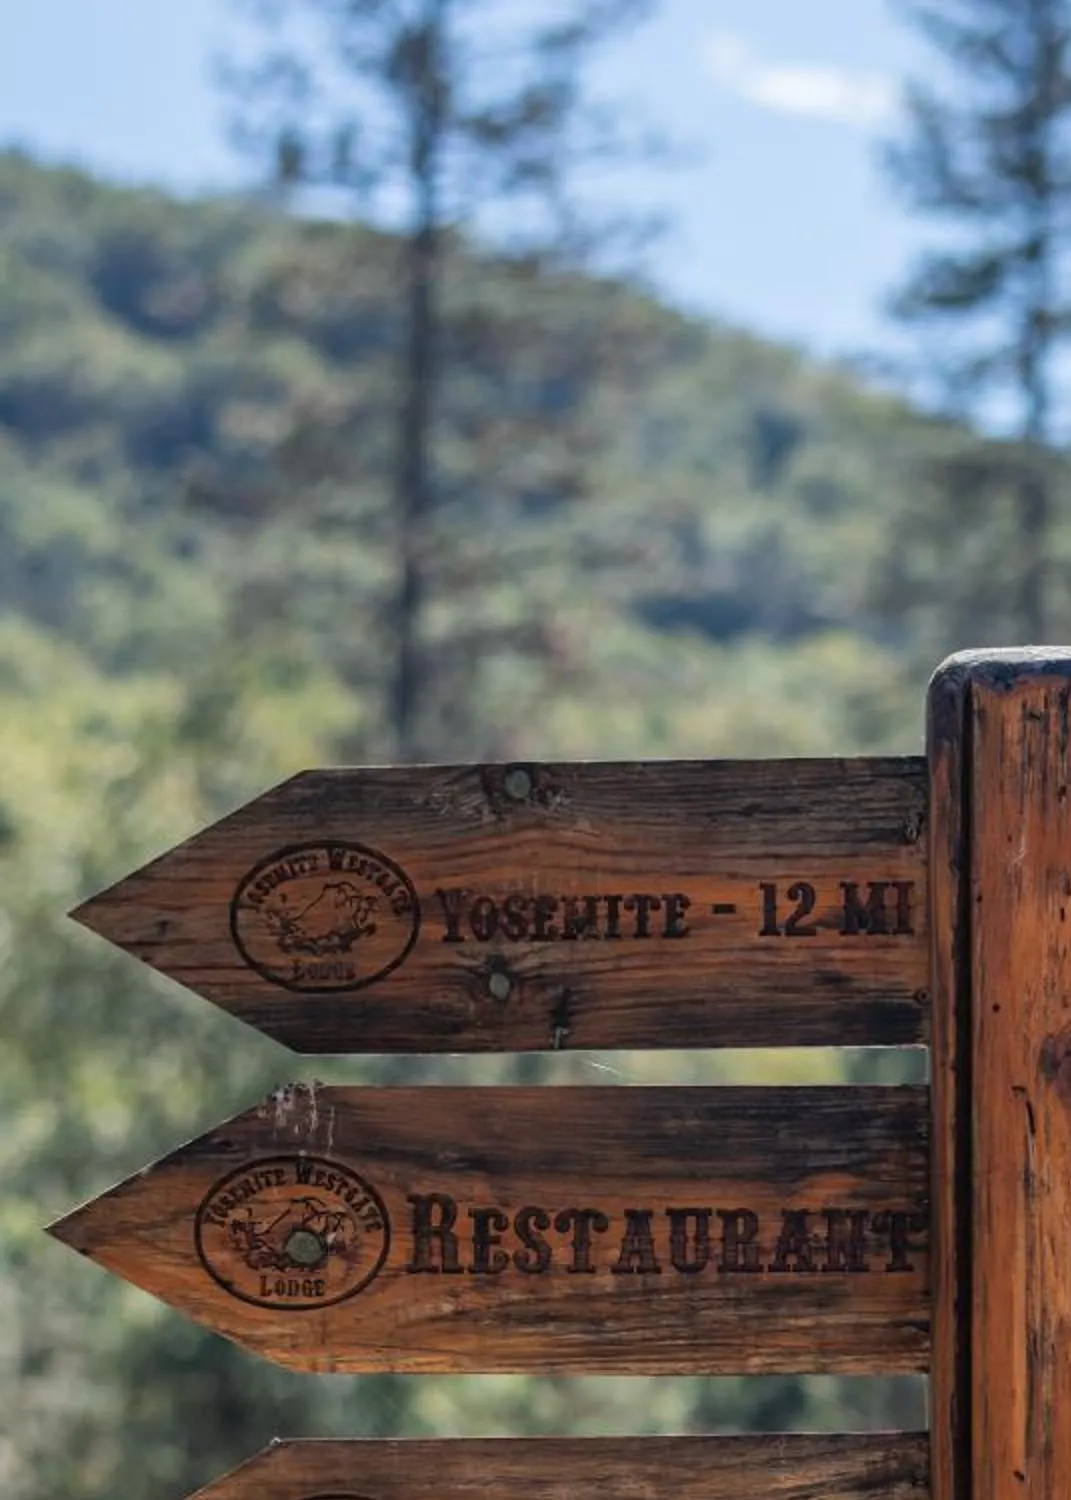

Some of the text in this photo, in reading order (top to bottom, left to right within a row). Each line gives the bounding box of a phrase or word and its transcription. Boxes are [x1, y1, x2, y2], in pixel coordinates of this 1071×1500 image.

[436, 887, 692, 943] YOSEMITE
[758, 881, 819, 938] 12
[839, 881, 915, 937] MI
[406, 1194, 926, 1275] RESTAURANT
[259, 1275, 326, 1298] LODGE
